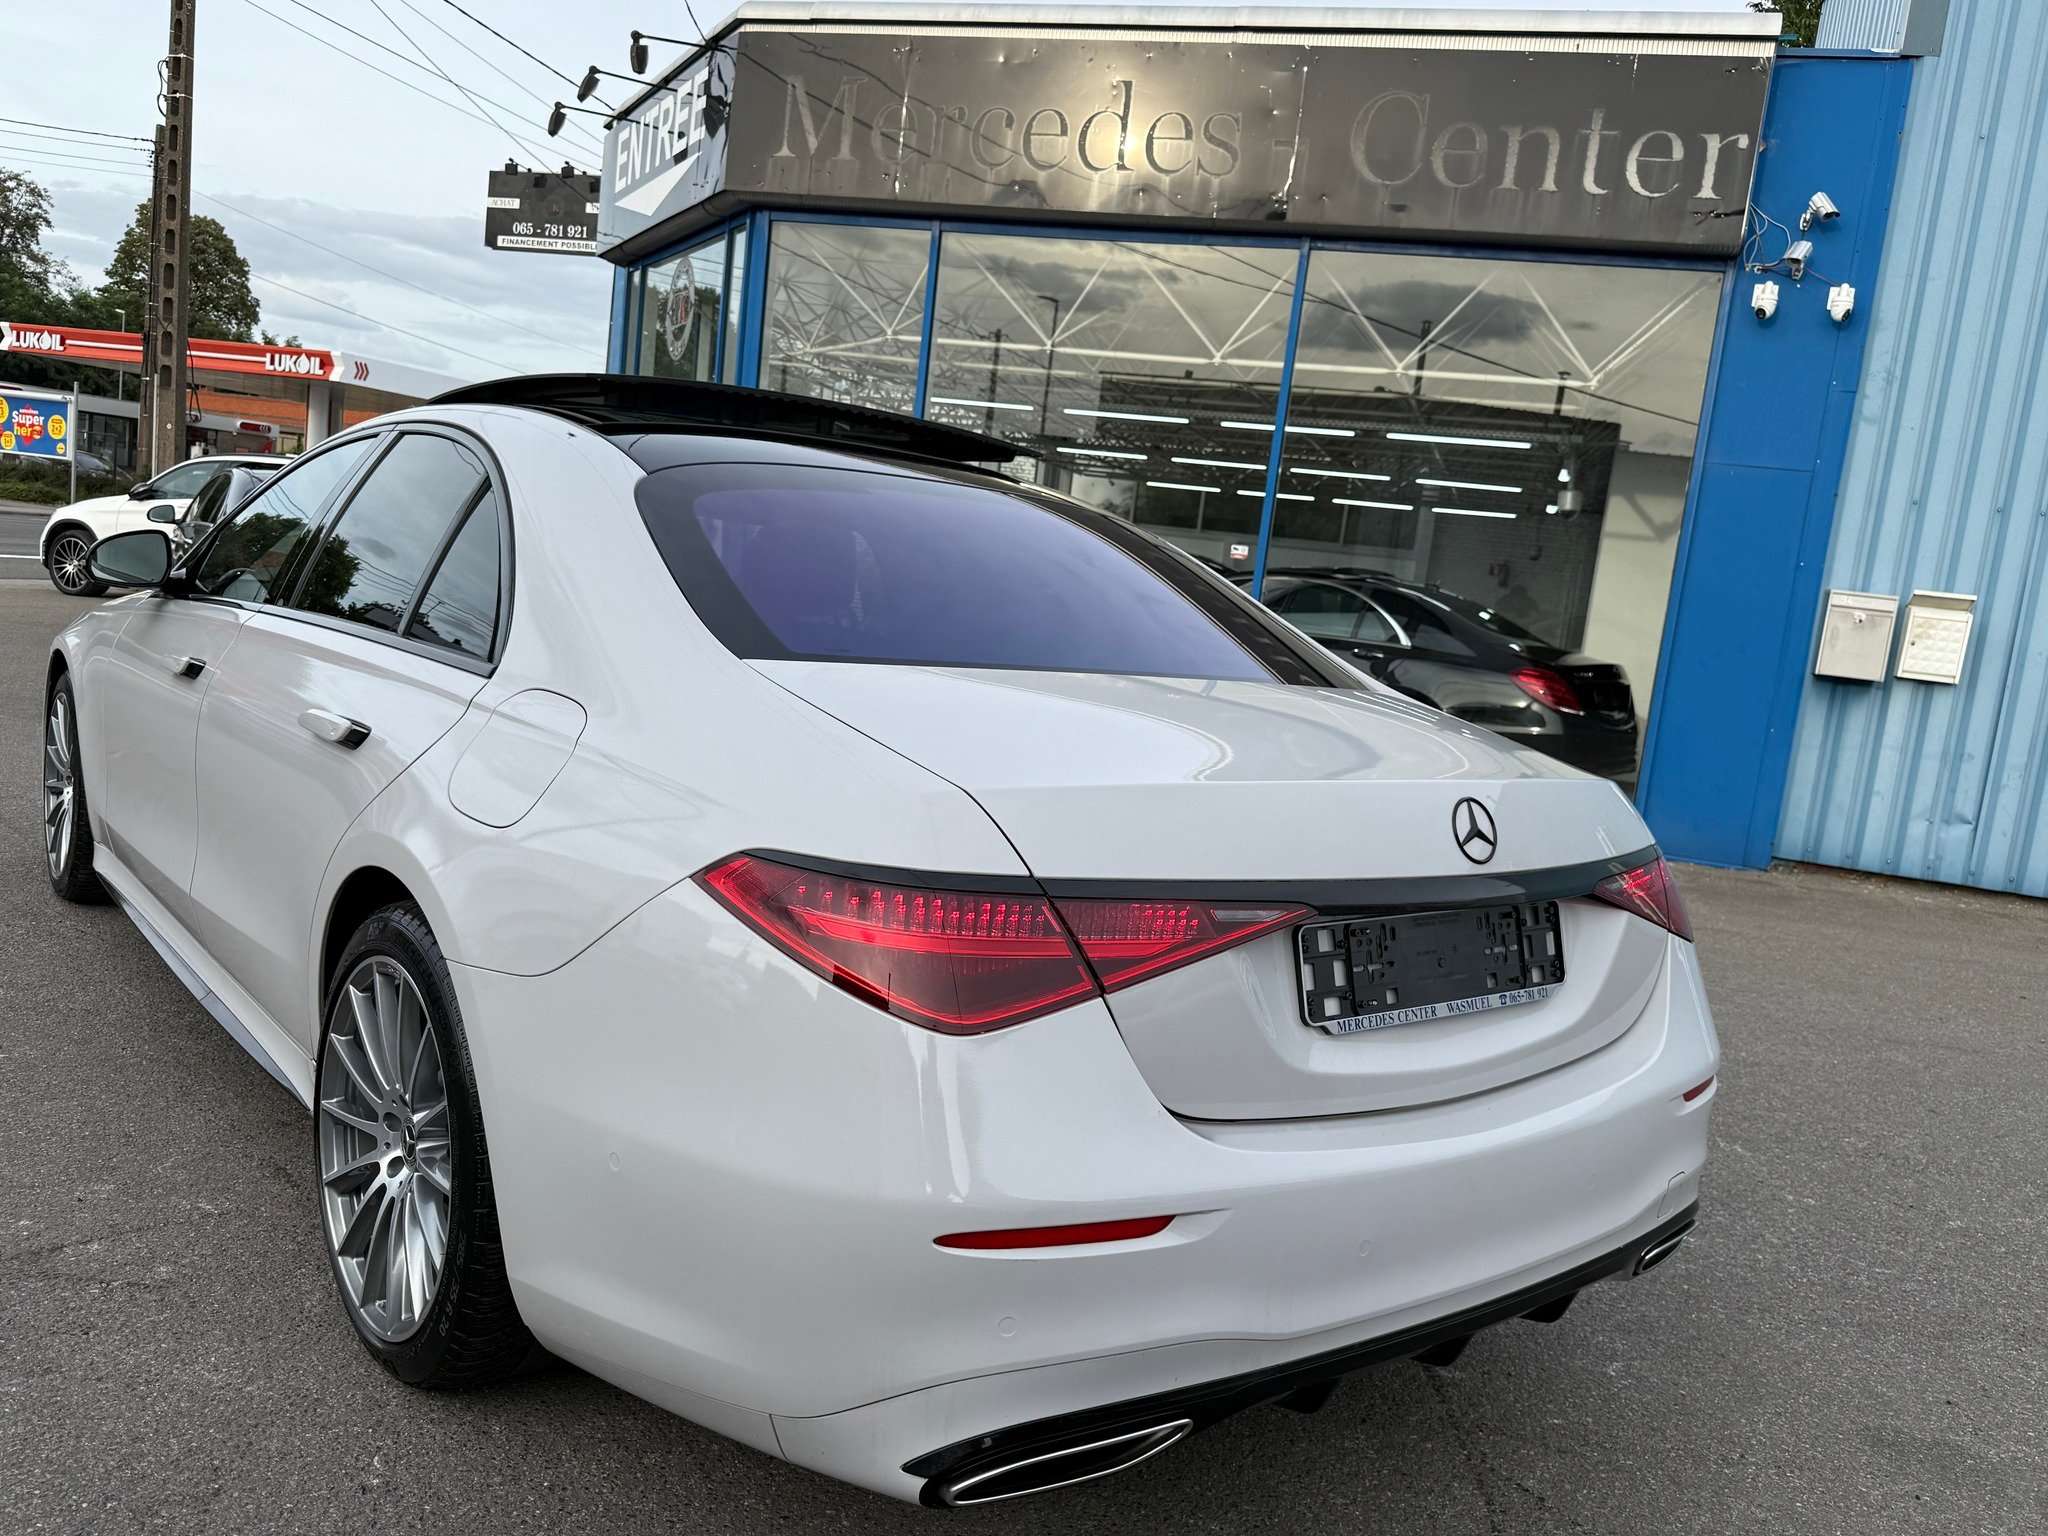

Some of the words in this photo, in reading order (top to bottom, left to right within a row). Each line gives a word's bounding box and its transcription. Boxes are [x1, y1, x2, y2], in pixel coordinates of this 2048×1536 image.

[615, 66, 709, 193] ENTREE
[773, 75, 1242, 178] Mercedes
[1350, 90, 1749, 200] Center
[512, 221, 534, 235] 065
[544, 223, 564, 237] 781
[567, 225, 588, 238] 921
[501, 237, 559, 249] FINANCEMENT
[11, 329, 65, 351] LUKOIL
[265, 352, 325, 376] LUKOIL
[12, 410, 45, 428] Super
[1336, 1011, 1394, 1034] MERCEDES
[1397, 1004, 1438, 1023] CENTER
[1446, 996, 1493, 1014] WASMUEL
[1508, 989, 1535, 1004] 065-781
[1536, 986, 1549, 999] 921
